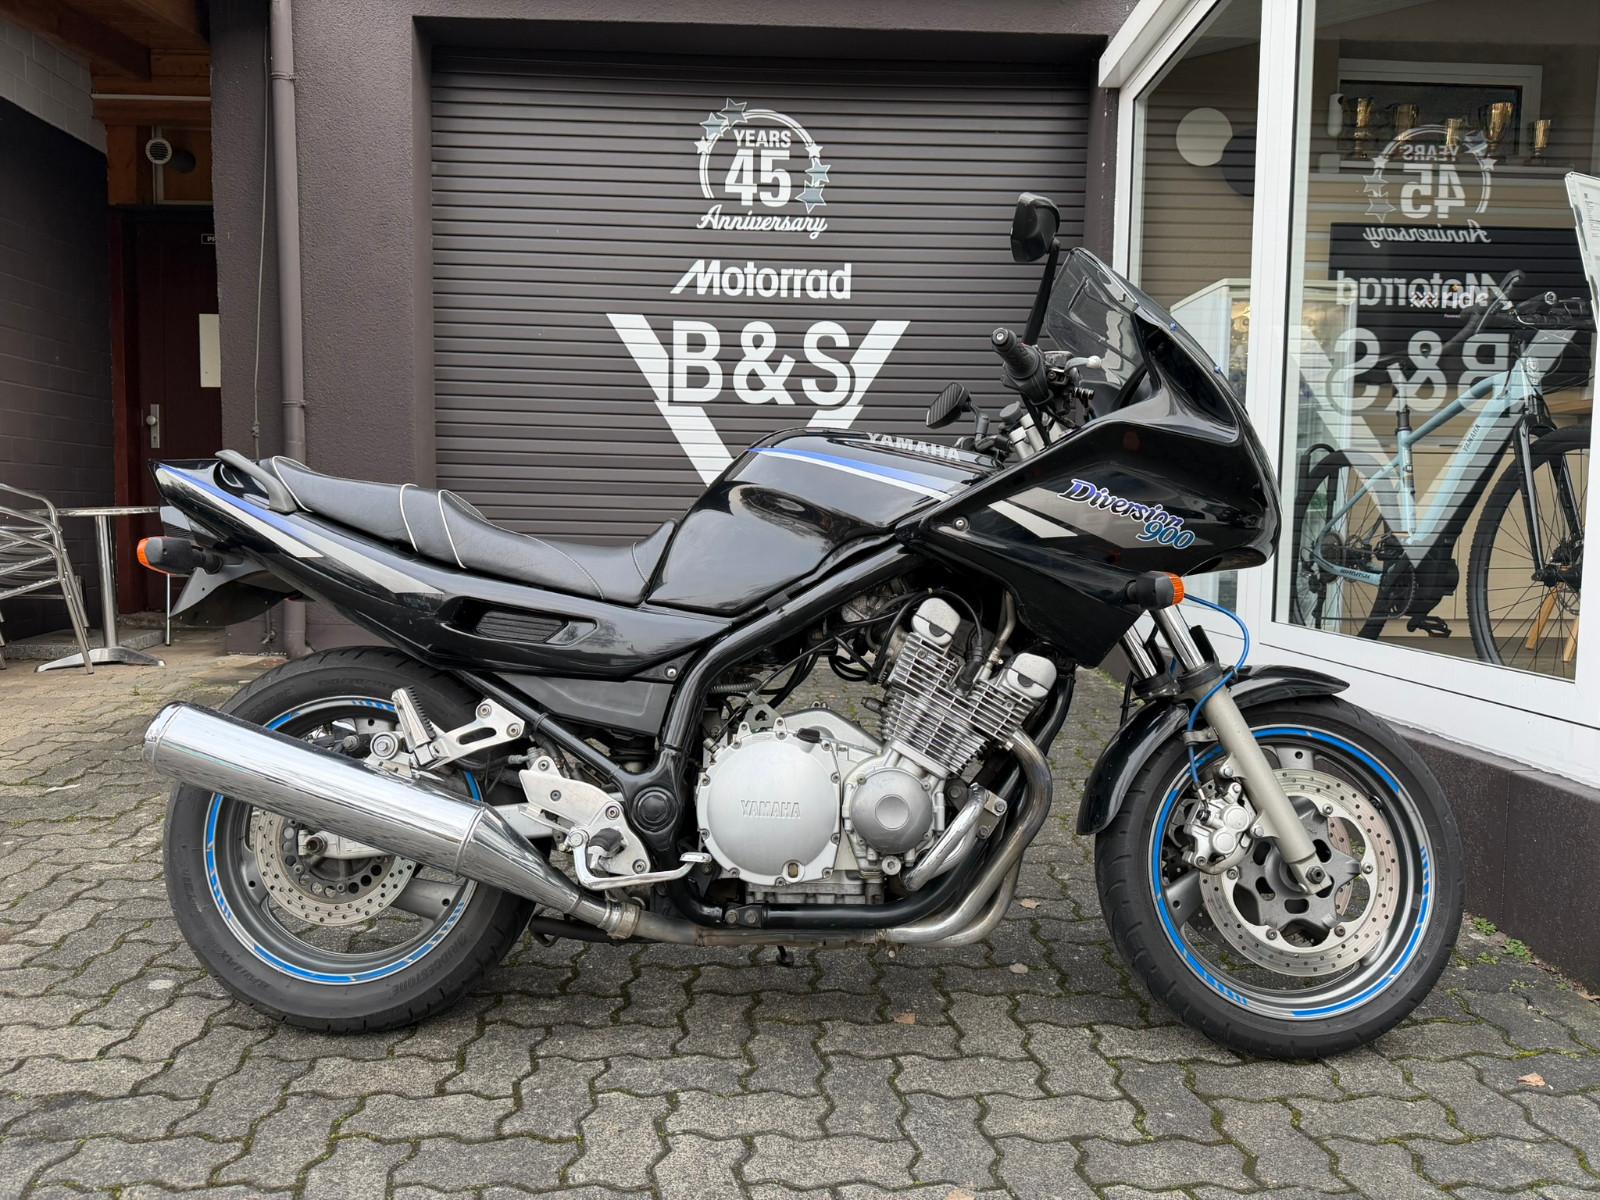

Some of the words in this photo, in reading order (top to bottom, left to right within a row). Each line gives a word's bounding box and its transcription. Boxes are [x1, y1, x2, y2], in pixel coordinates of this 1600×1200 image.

[733, 128, 792, 148] YEARS
[724, 149, 792, 207] 45
[696, 203, 828, 240] Anniversary
[670, 259, 853, 300] Motorrad
[672, 319, 854, 406] B&S
[866, 432, 961, 461] YAMAHA
[1057, 478, 1185, 529] Diversion
[1136, 520, 1195, 549] 900
[740, 799, 801, 818] YAMAHA
